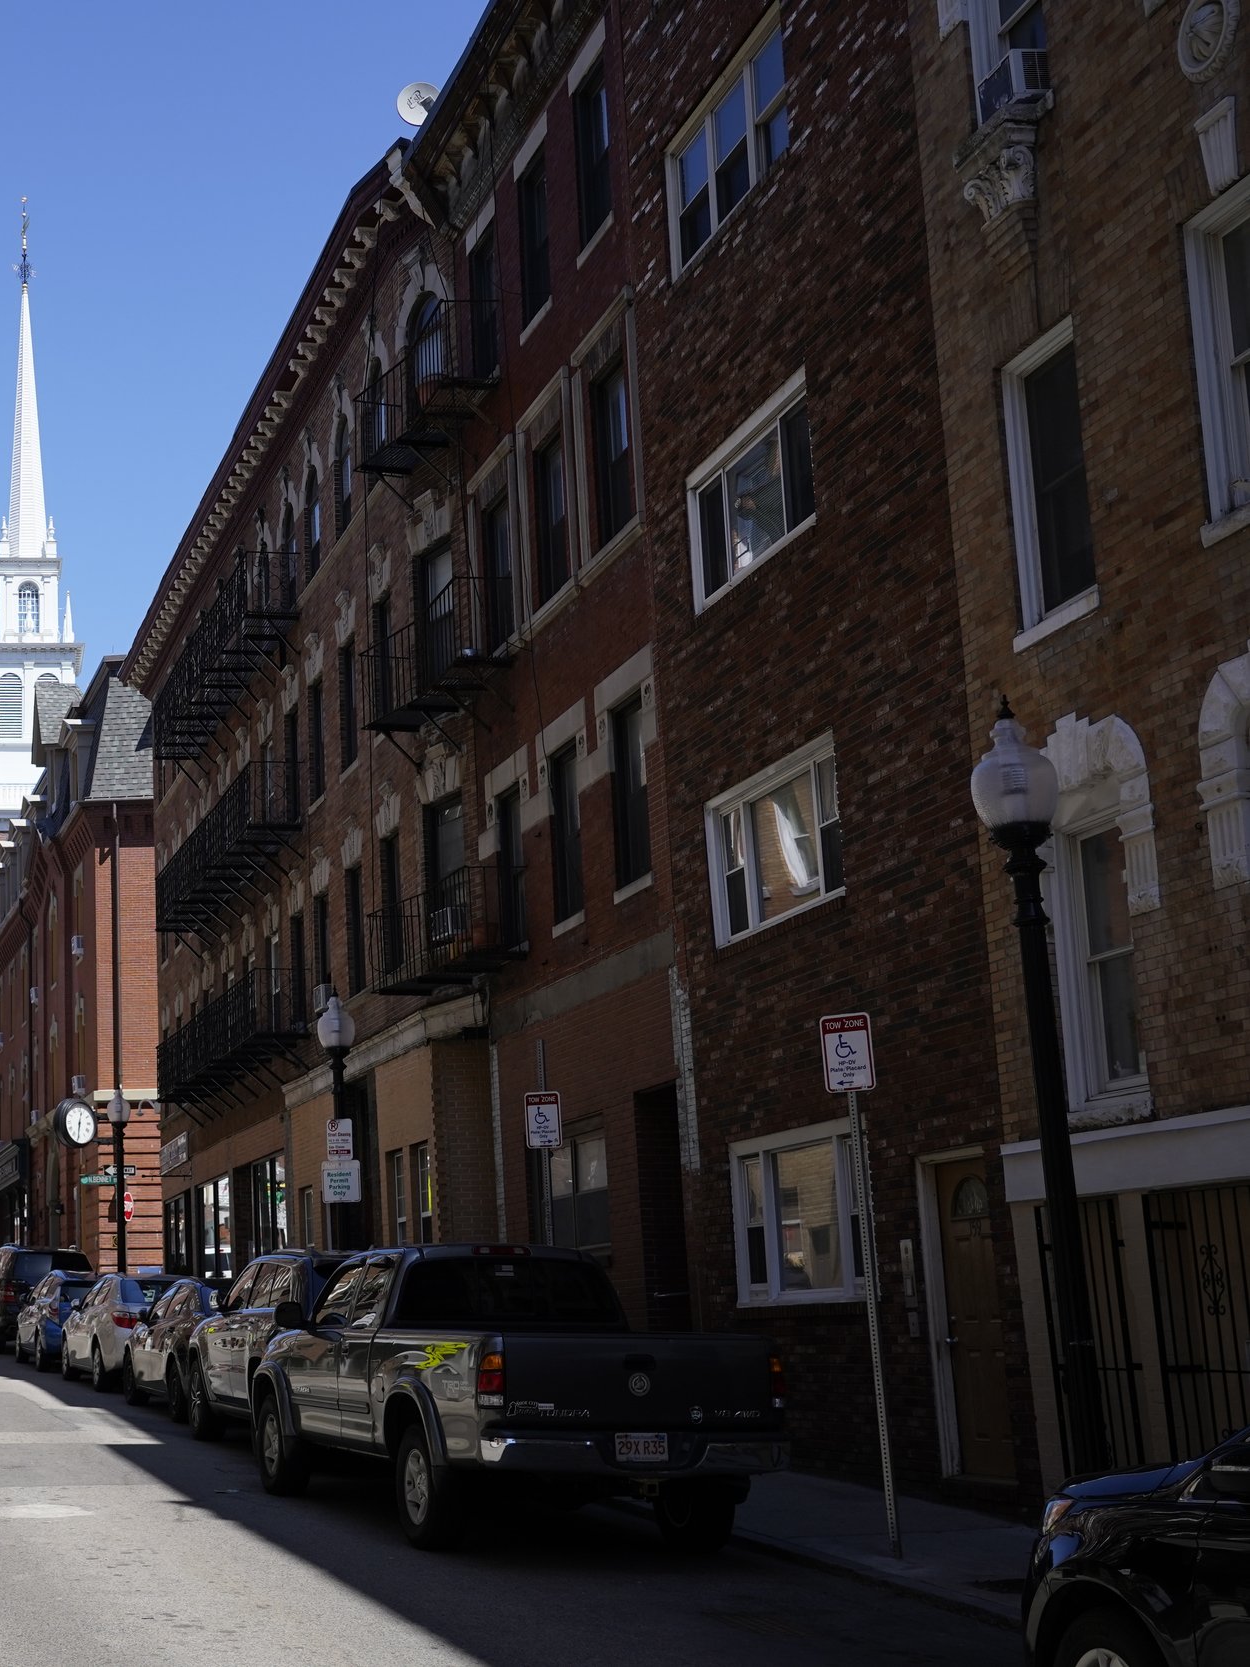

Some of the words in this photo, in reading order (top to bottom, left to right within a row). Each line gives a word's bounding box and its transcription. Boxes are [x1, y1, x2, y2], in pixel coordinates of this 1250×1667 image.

[825, 1022, 842, 1030] TOW
[844, 1019, 865, 1029] ZONE
[541, 1095, 556, 1103] ZONE
[618, 1440, 640, 1455] 29X
[643, 1440, 666, 1455] R35
